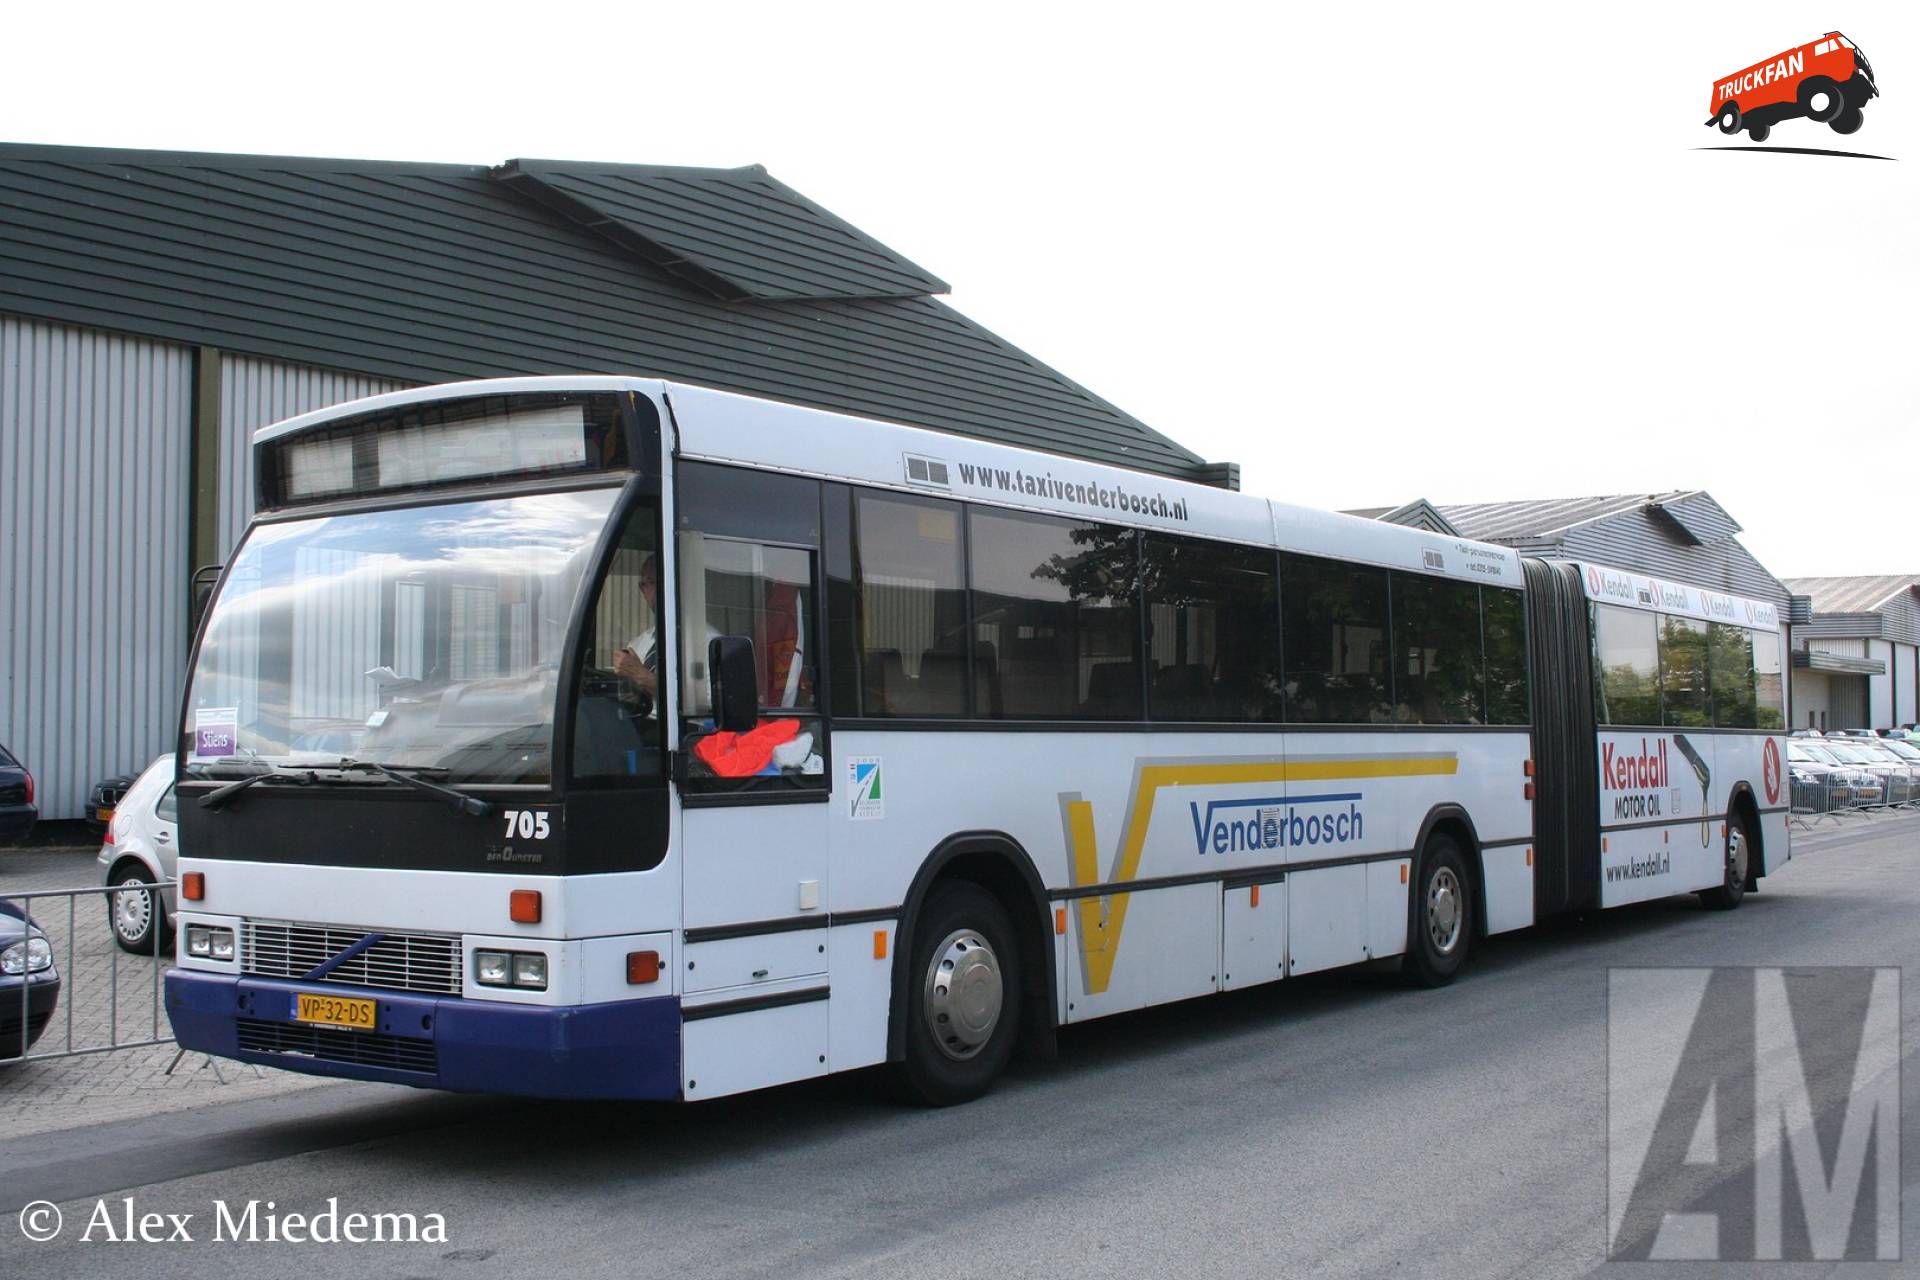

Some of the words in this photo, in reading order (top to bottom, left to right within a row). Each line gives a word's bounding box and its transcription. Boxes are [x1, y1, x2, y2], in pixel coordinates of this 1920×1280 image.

[958, 463, 1189, 521] www.taxivenderbosch.nl
[1600, 572, 1634, 599] Kendall
[1602, 738, 1668, 790] Kendall
[1614, 795, 1646, 820] MOTOR
[504, 810, 550, 839] 705
[1190, 793, 1363, 855] Venderbosch
[1606, 852, 1670, 882] www.kendall.nl
[302, 998, 370, 1024] VP-32-DS
